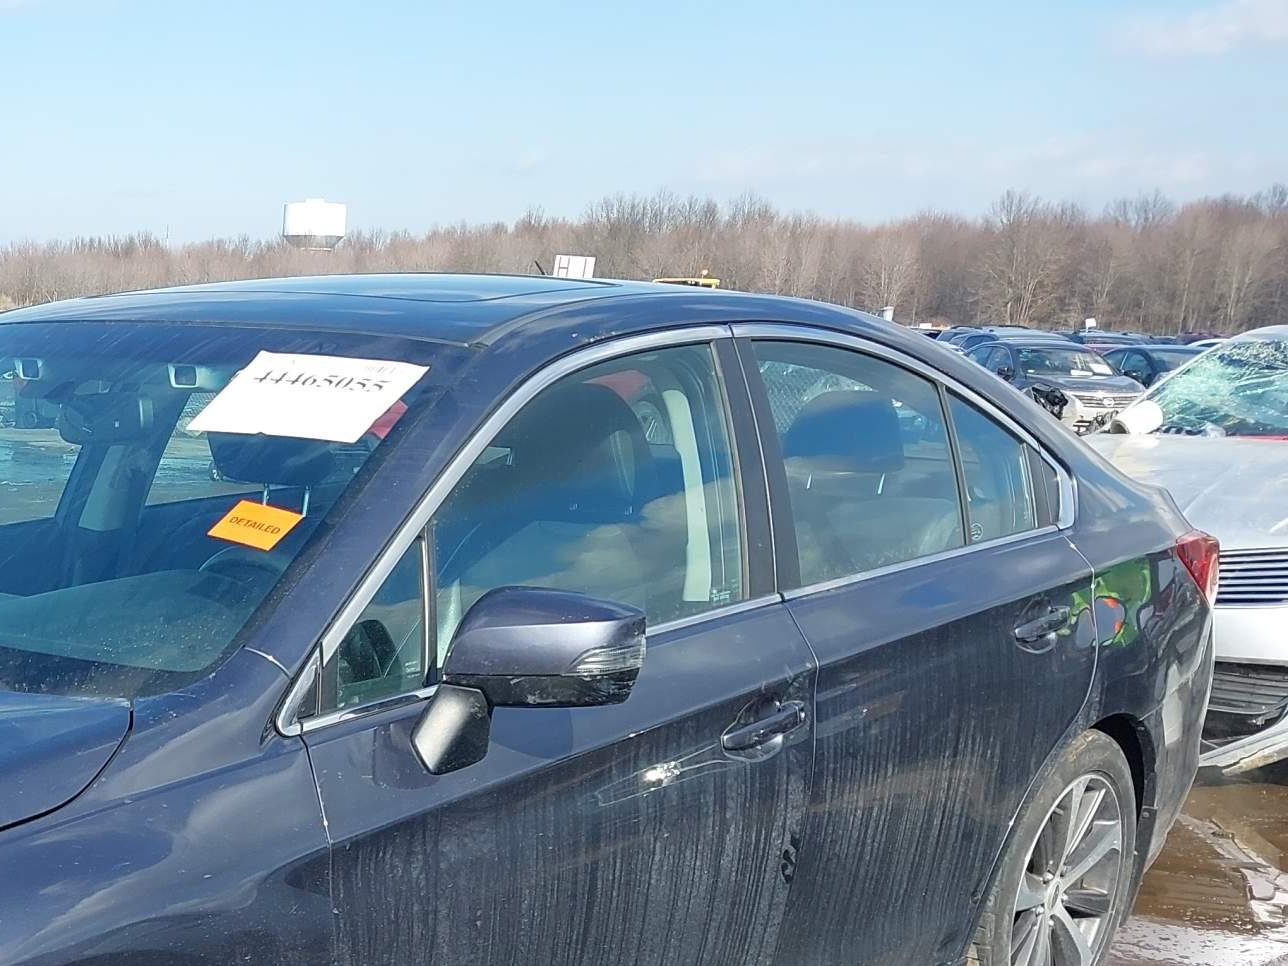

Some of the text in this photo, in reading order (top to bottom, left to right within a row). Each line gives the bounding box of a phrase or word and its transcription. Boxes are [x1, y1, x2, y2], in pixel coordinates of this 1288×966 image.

[557, 256, 570, 278] H
[253, 370, 391, 392] 44465055
[229, 516, 281, 535] DETAILED
